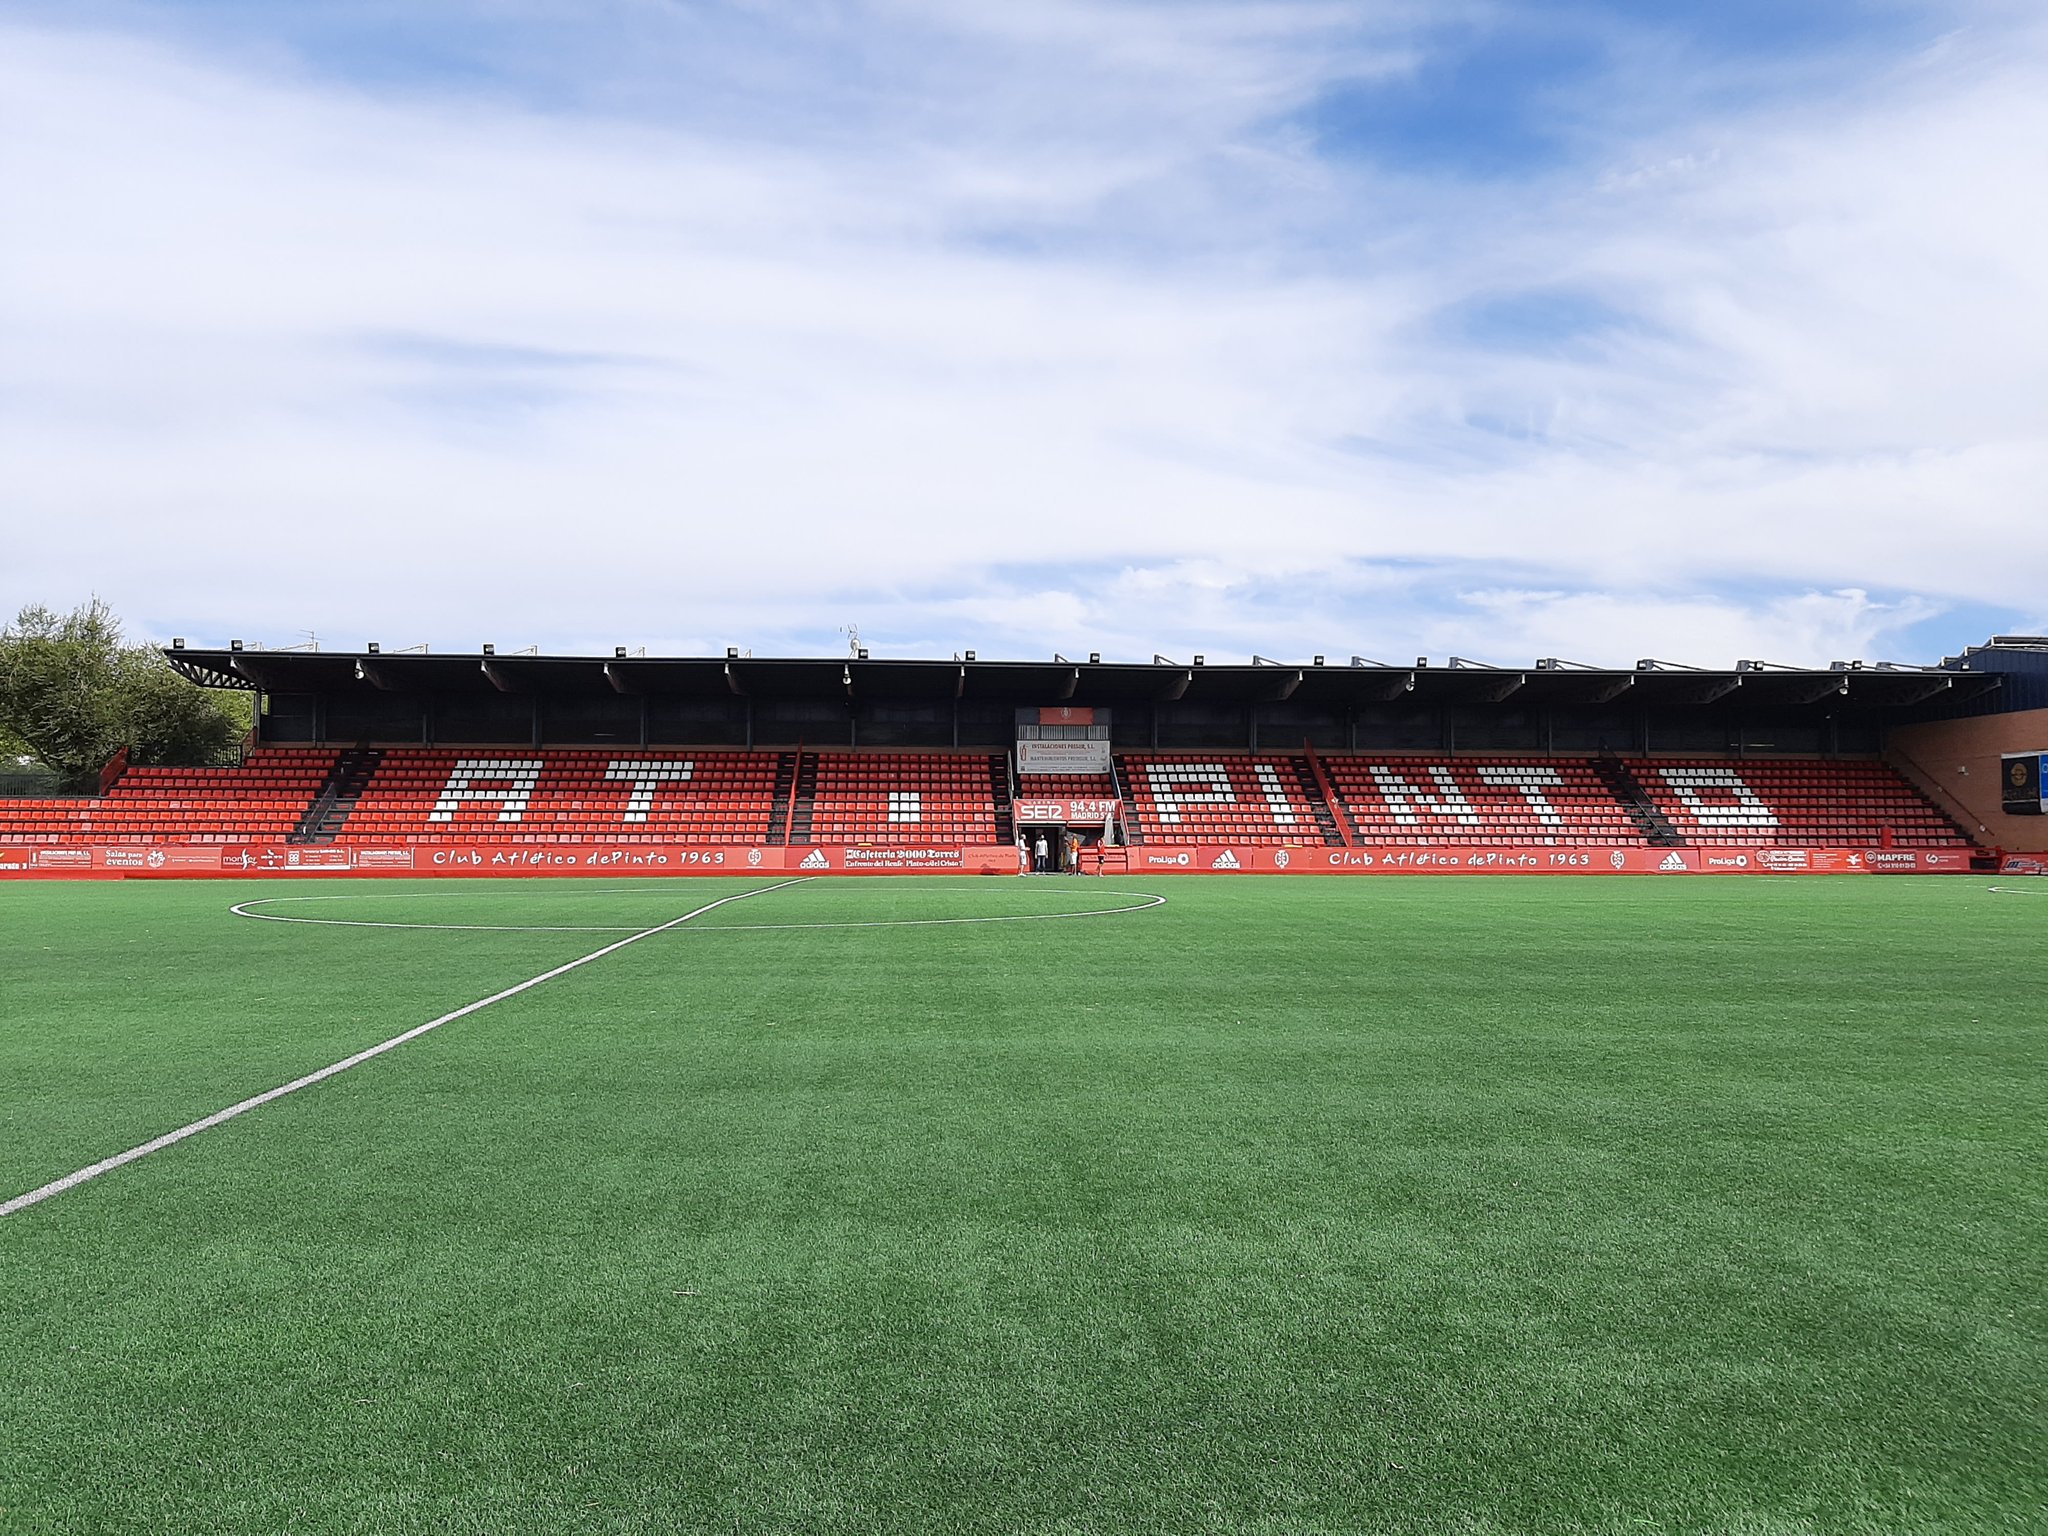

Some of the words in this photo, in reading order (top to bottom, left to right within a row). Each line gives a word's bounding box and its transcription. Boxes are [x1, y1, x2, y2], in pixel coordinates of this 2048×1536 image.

[1146, 763, 1781, 826] PINTO
[1070, 800, 1096, 812] 94.4
[1098, 801, 1116, 812] FM
[1020, 804, 1063, 820] SER
[1071, 811, 1100, 820] MADRID
[105, 849, 126, 858] Salas
[432, 849, 482, 865] Club
[680, 851, 725, 864] 1963
[1877, 853, 1916, 861] MAPFRE
[106, 858, 143, 866] eventos
[1148, 855, 1177, 865] ProLiga
[1329, 852, 1374, 866] Club
[1549, 853, 1590, 866] 1963
[1708, 857, 1735, 866] ProLiga
[799, 860, 830, 869] adidas
[1212, 860, 1241, 869] adidas
[1659, 862, 1687, 871] adidas
